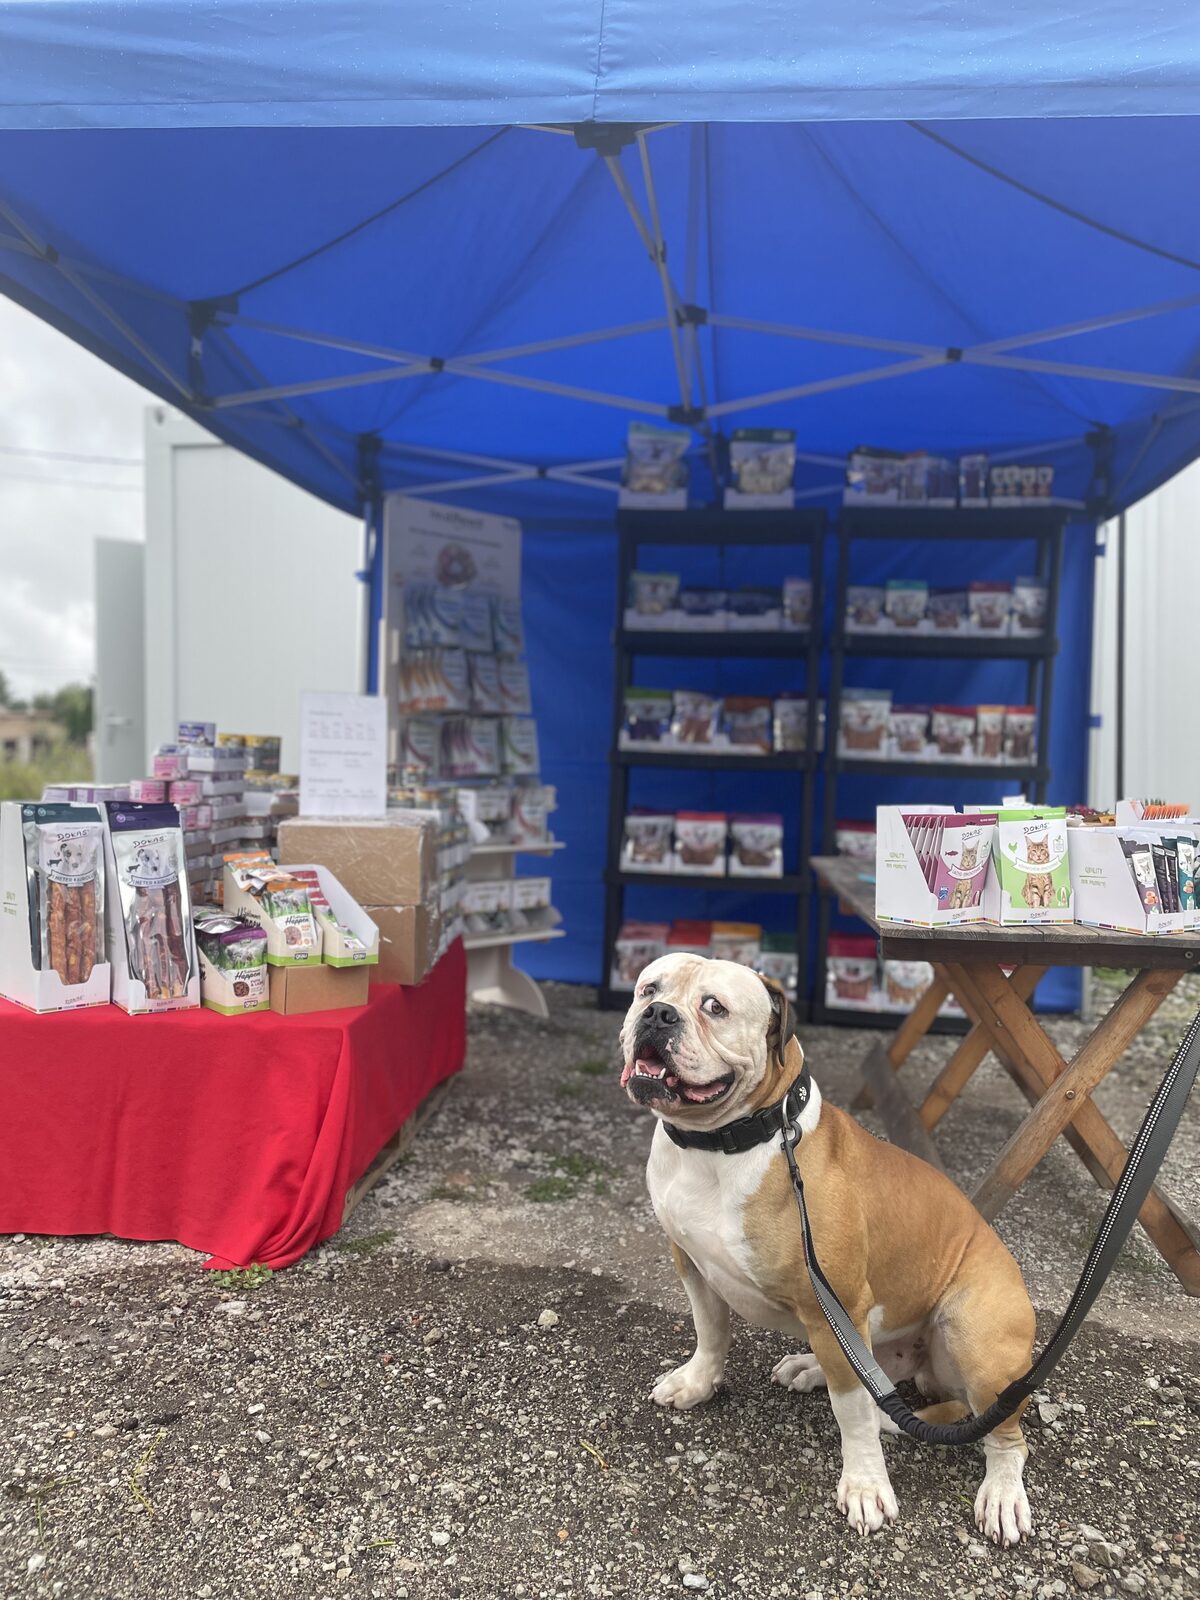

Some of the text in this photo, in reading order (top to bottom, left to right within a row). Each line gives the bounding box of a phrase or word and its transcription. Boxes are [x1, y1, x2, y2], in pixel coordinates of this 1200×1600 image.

[1024, 822, 1048, 834] DOKAS
[57, 830, 87, 841] DOKAS
[133, 837, 164, 848] DOKAS
